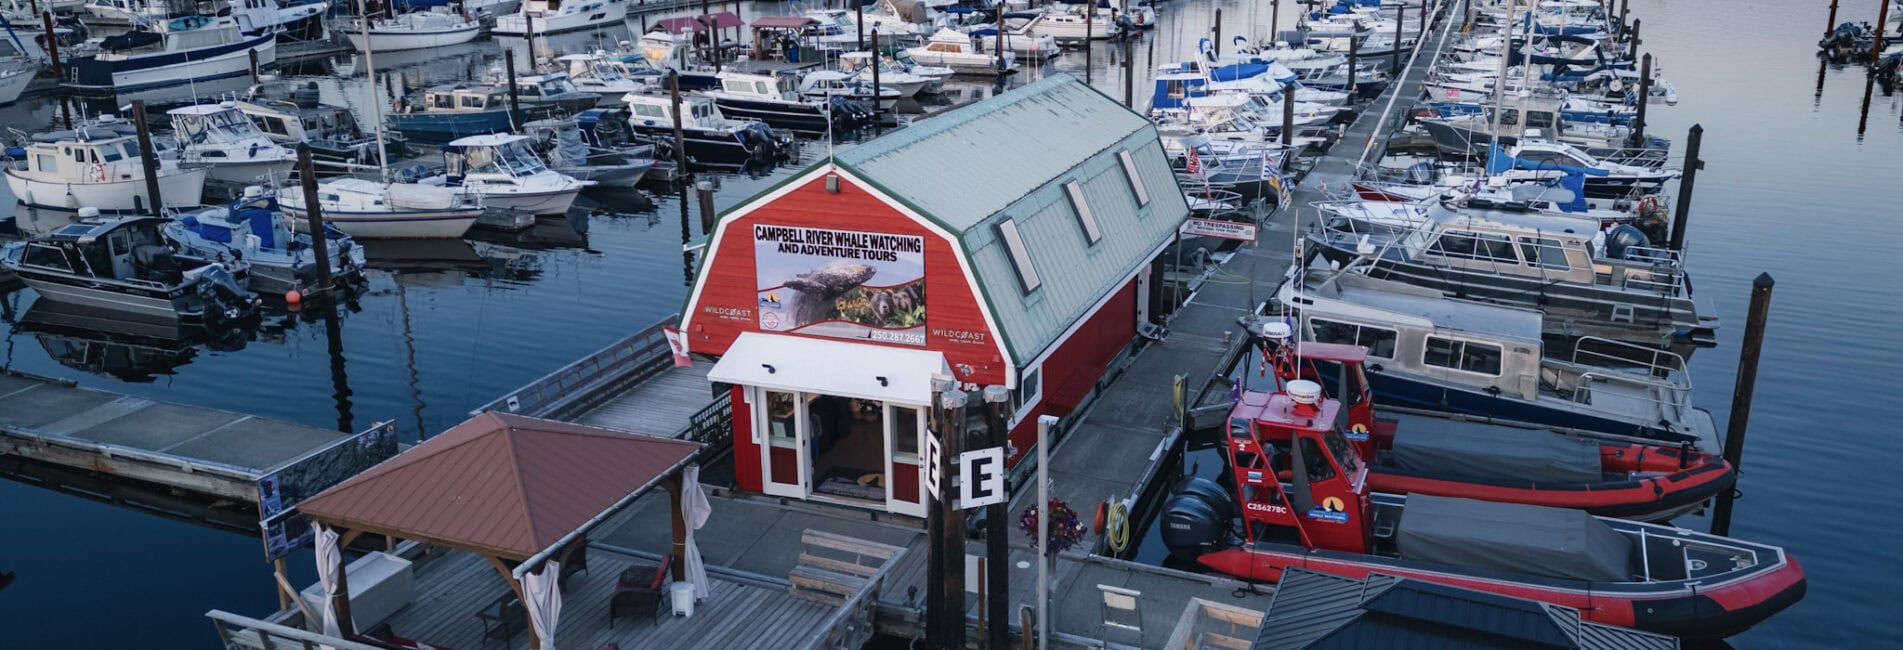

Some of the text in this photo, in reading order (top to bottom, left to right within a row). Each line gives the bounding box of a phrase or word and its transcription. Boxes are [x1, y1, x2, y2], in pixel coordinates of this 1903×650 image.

[1204, 221, 1244, 230] TRESPASSING
[755, 226, 921, 253] CAMPBELL RIVER WHALE WATCHING
[778, 243, 897, 262] AND ADVENTURE TOURS
[872, 330, 925, 344] 250.287.2667
[929, 442, 937, 488] E
[971, 457, 992, 499] E
[1247, 502, 1287, 514] C25627BC
[1170, 522, 1191, 530] YAMAHA
